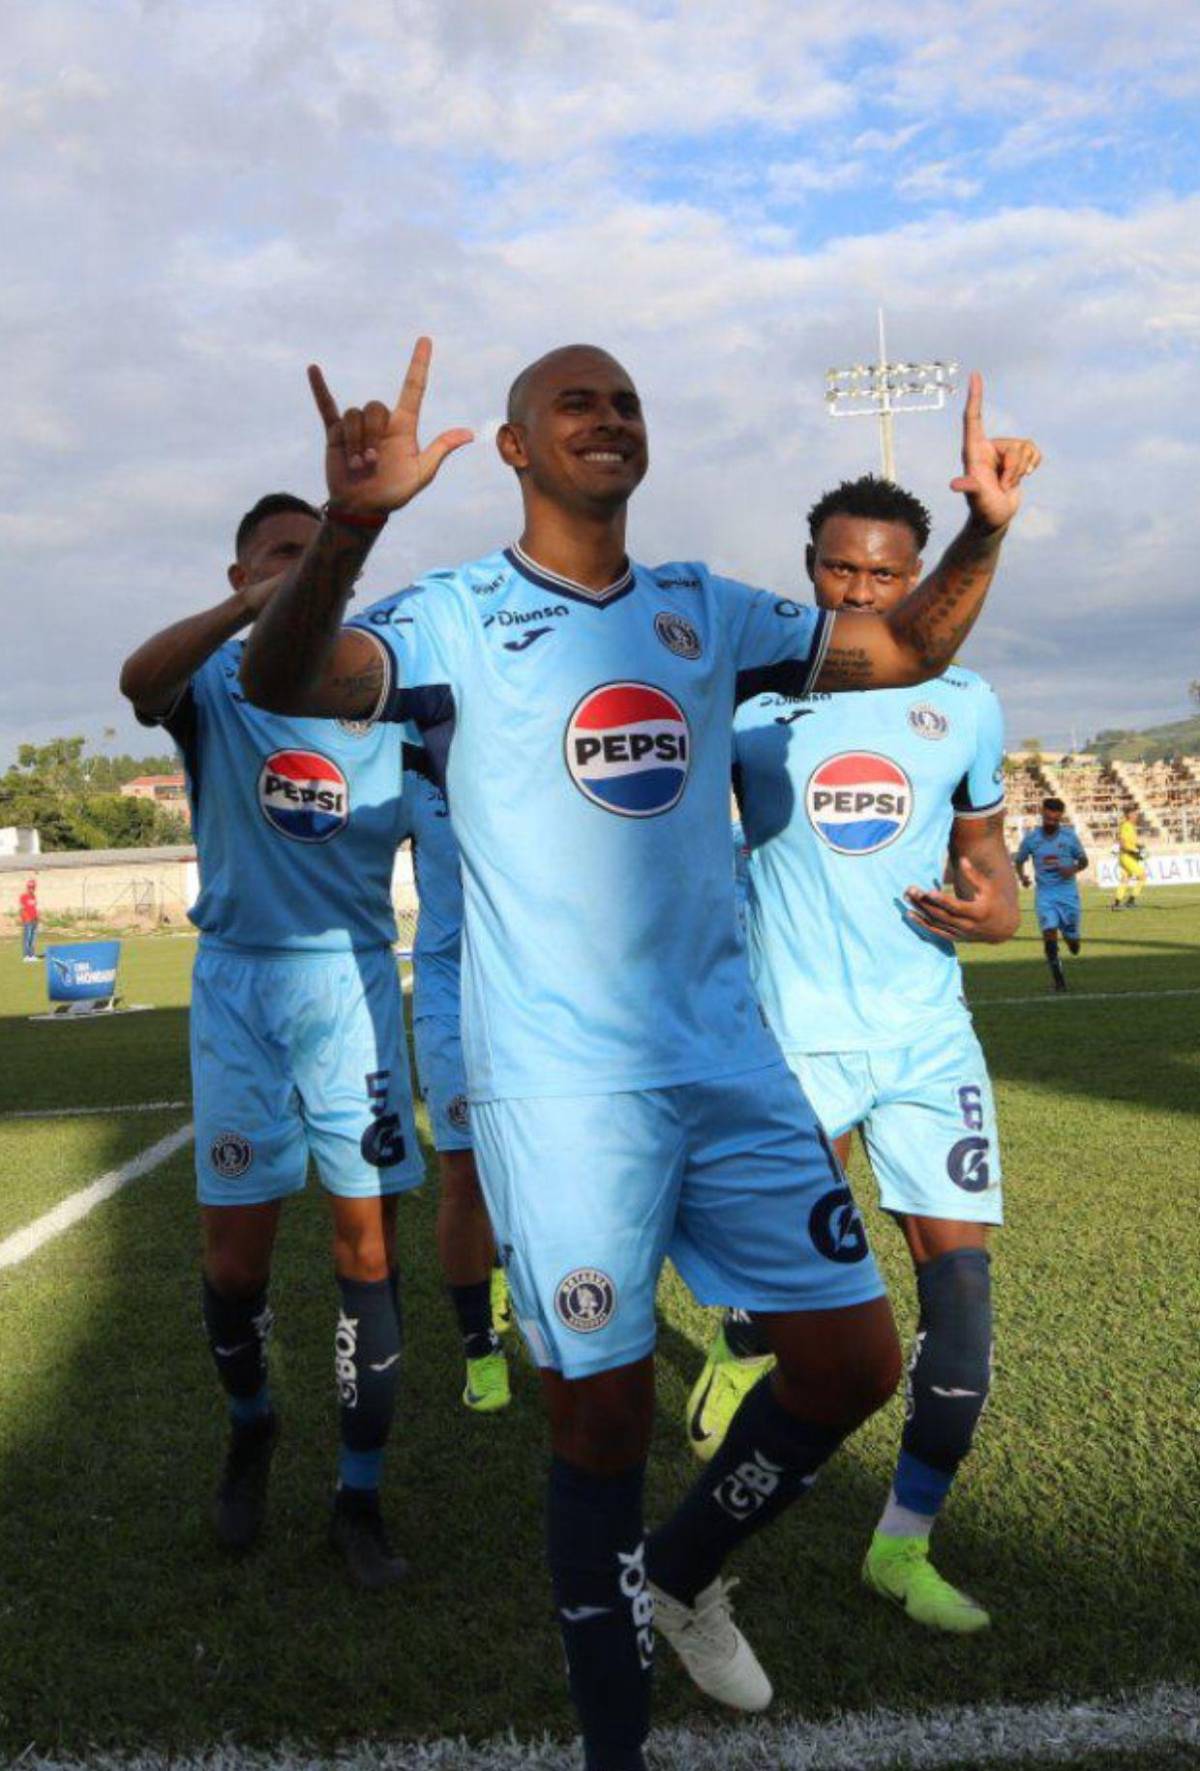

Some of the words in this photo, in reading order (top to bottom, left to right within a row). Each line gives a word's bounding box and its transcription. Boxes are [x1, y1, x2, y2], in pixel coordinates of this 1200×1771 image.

[575, 733, 686, 766] PEPSI
[265, 775, 343, 813] PEPSI
[813, 791, 905, 816] PEPSI
